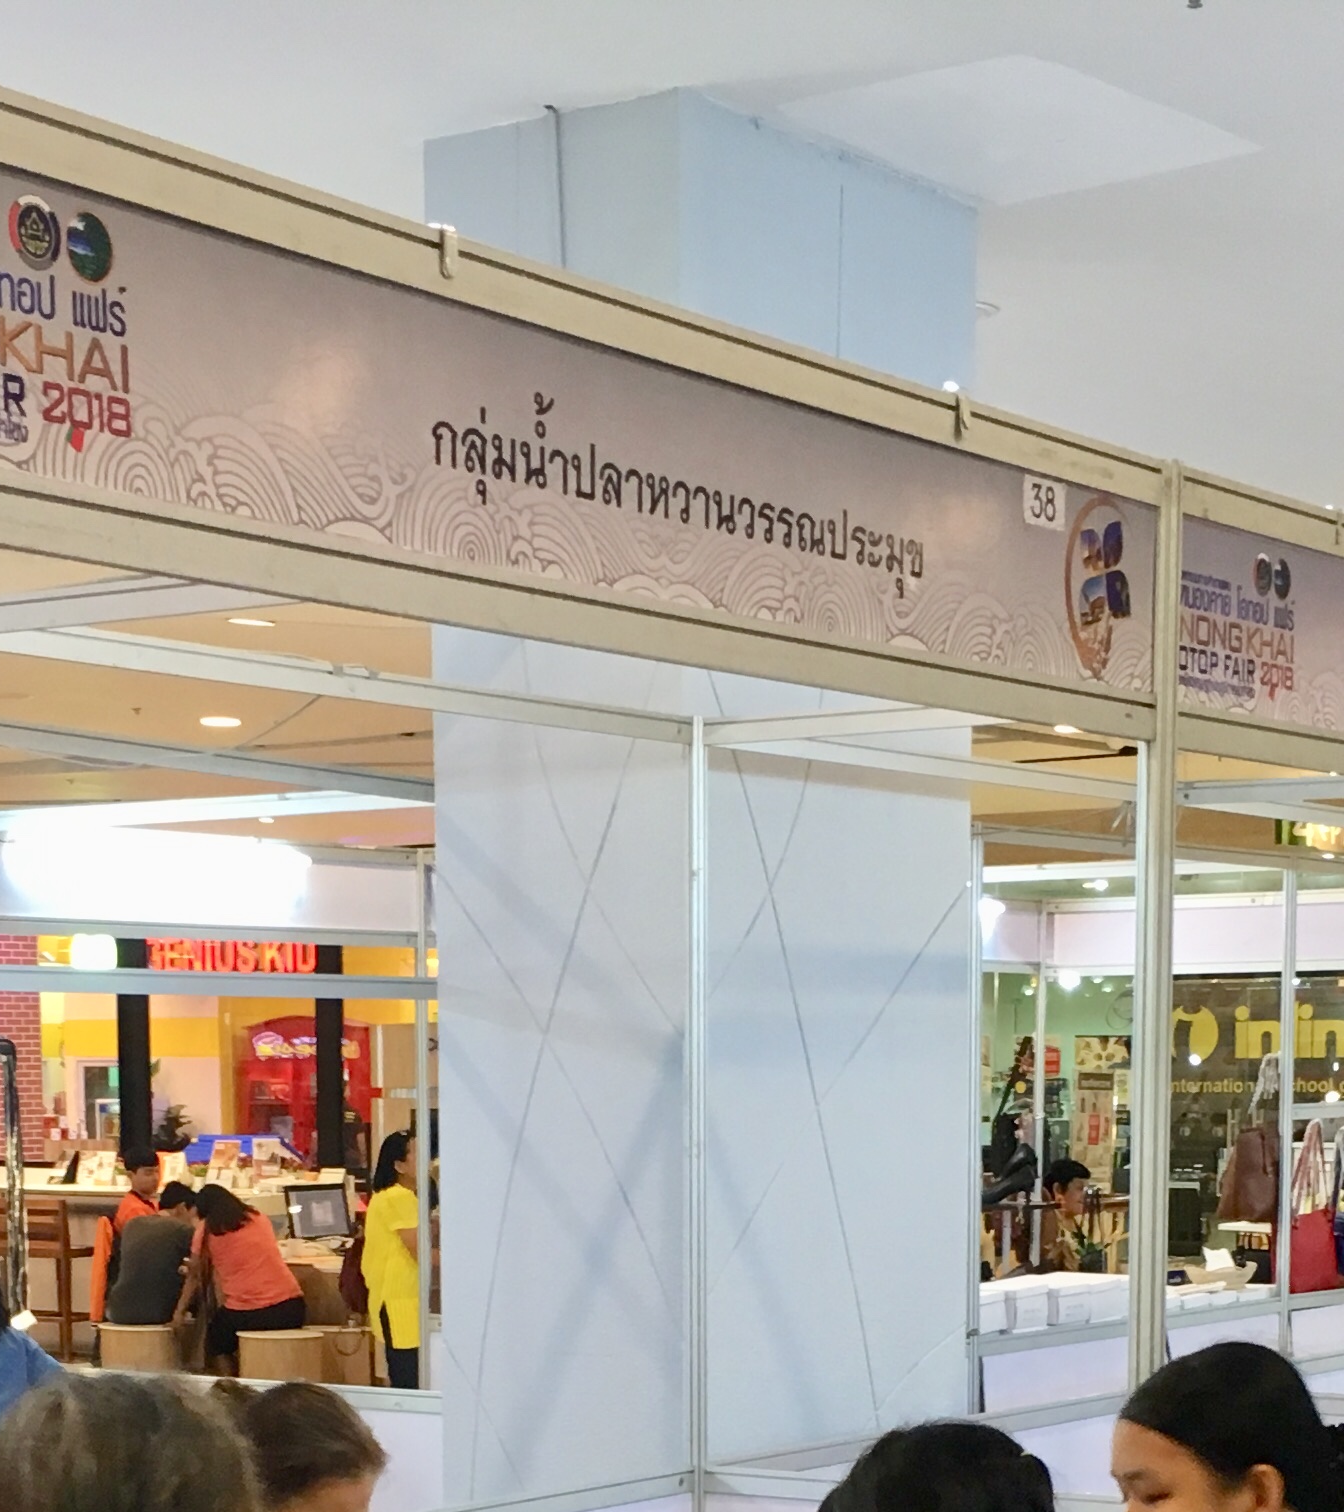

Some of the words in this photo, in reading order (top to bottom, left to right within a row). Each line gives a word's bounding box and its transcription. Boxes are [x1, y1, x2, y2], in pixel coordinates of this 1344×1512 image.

[72, 286, 127, 337] แฟร์
[42, 381, 132, 438] 2018
[1030, 483, 1056, 522] 38
[1179, 613, 1243, 654] NONG
[1246, 625, 1294, 664] KHAI
[1224, 654, 1255, 684] FAIR
